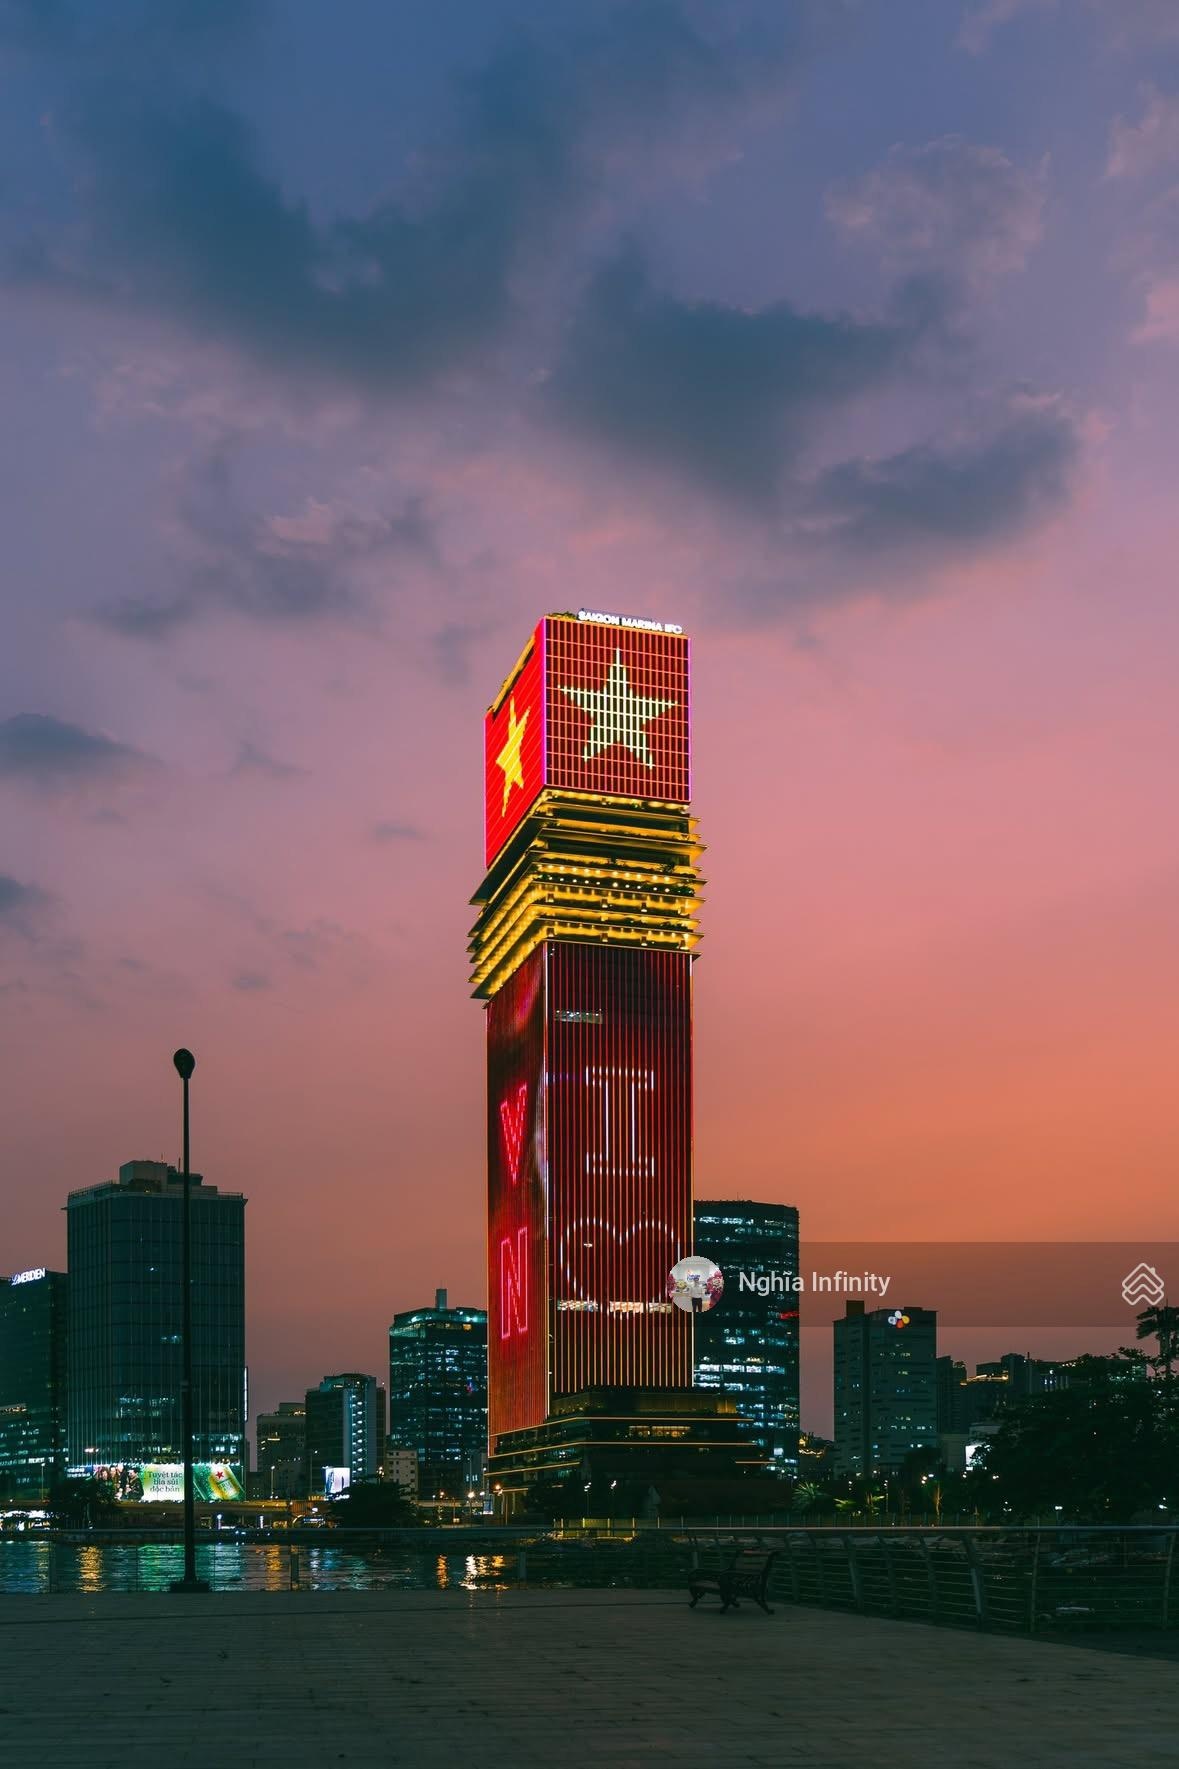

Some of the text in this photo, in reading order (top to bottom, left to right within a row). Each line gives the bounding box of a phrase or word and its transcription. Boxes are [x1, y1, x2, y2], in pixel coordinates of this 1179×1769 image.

[578, 611, 683, 634] SAIGON MARINA IFC
